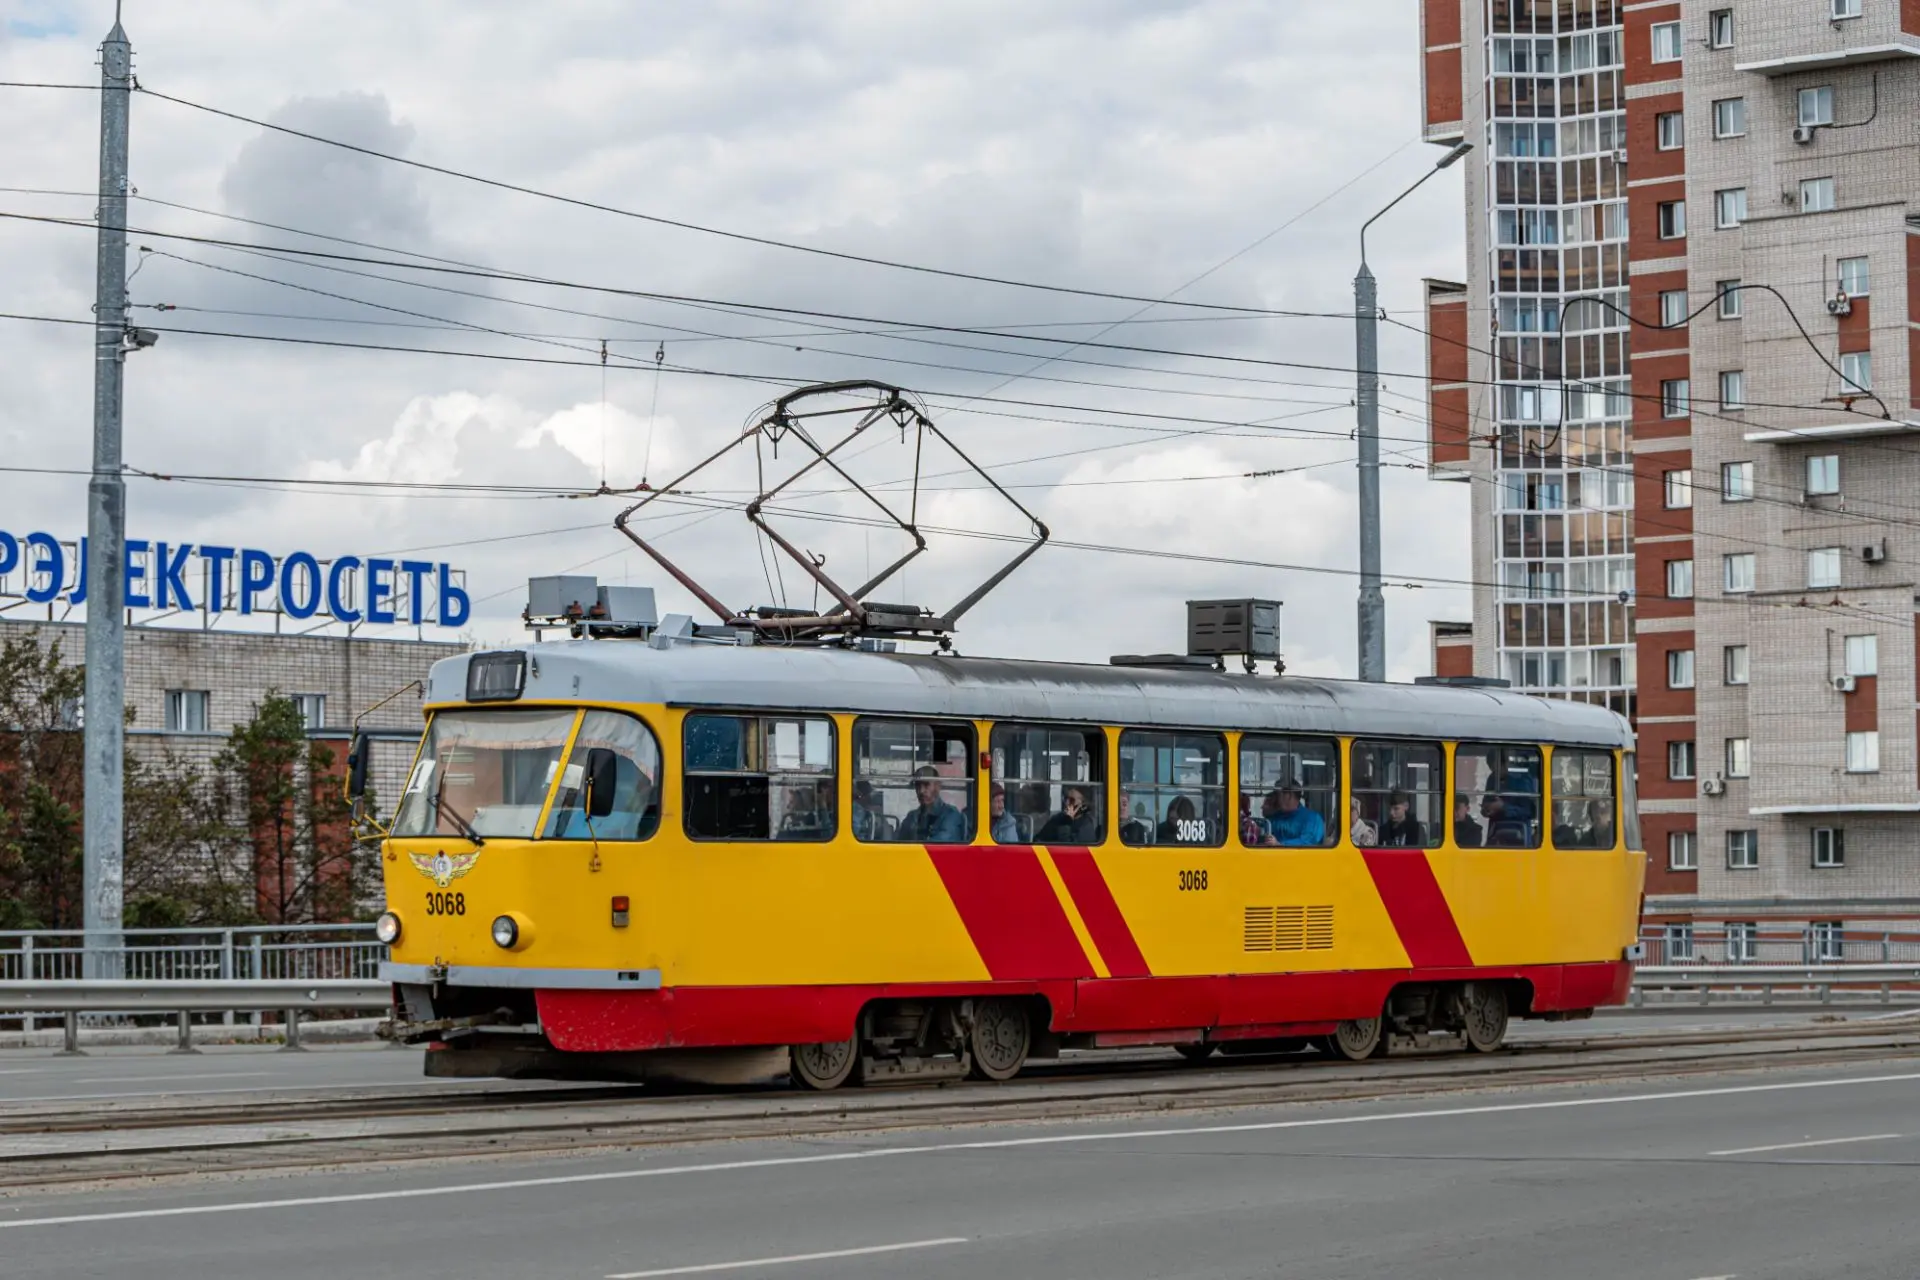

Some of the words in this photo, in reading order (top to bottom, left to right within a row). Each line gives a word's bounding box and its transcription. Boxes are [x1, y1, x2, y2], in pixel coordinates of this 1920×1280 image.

[1176, 819, 1206, 841] 3068
[1178, 870, 1208, 891] 3068
[425, 892, 466, 916] 3068
